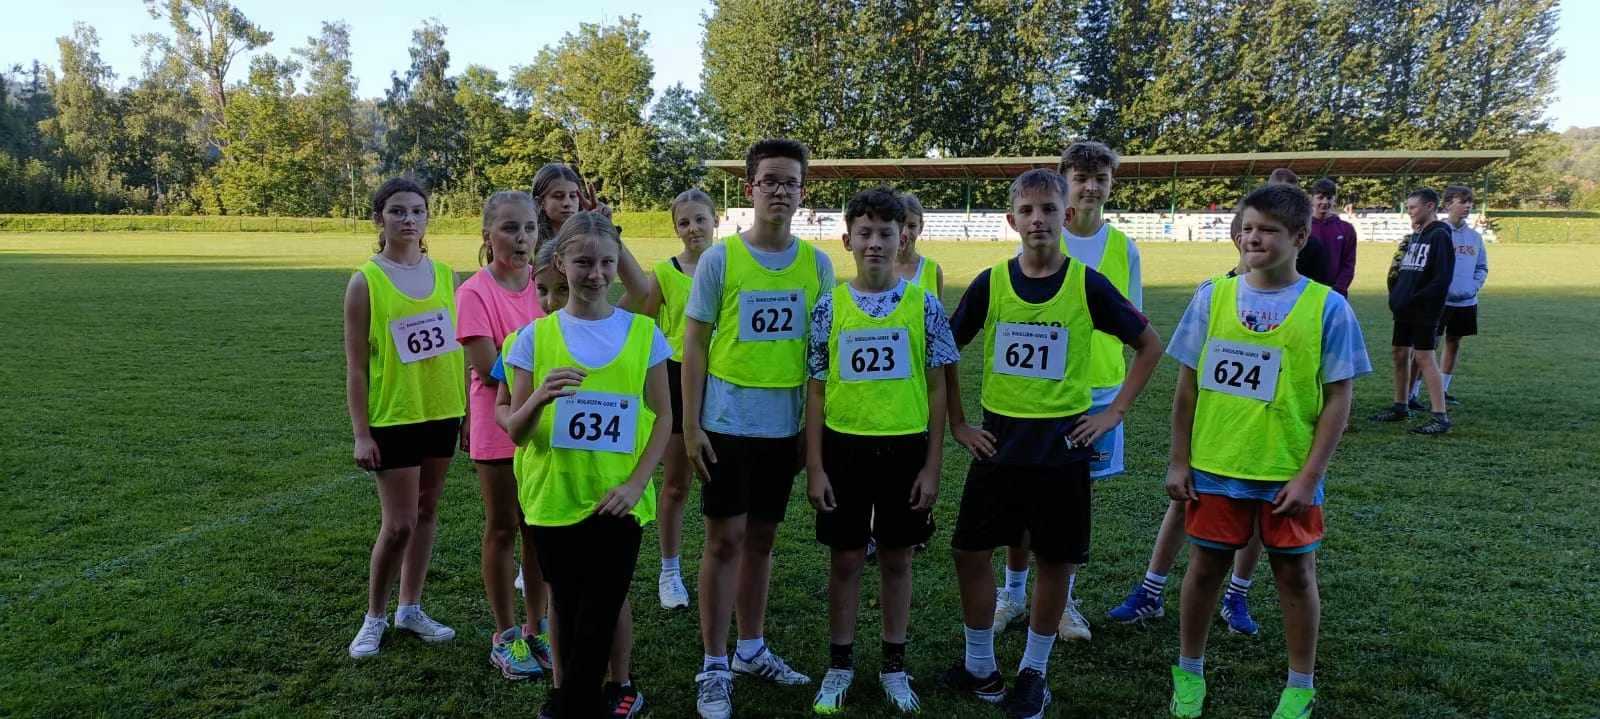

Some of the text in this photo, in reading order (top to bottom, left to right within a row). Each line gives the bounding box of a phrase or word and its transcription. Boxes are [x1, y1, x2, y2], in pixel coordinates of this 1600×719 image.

[751, 307, 793, 333] 622
[407, 326, 445, 354] 633
[851, 346, 895, 373] 623
[1005, 342, 1049, 370] 621
[1214, 359, 1261, 390] 624
[568, 411, 621, 443] 634
